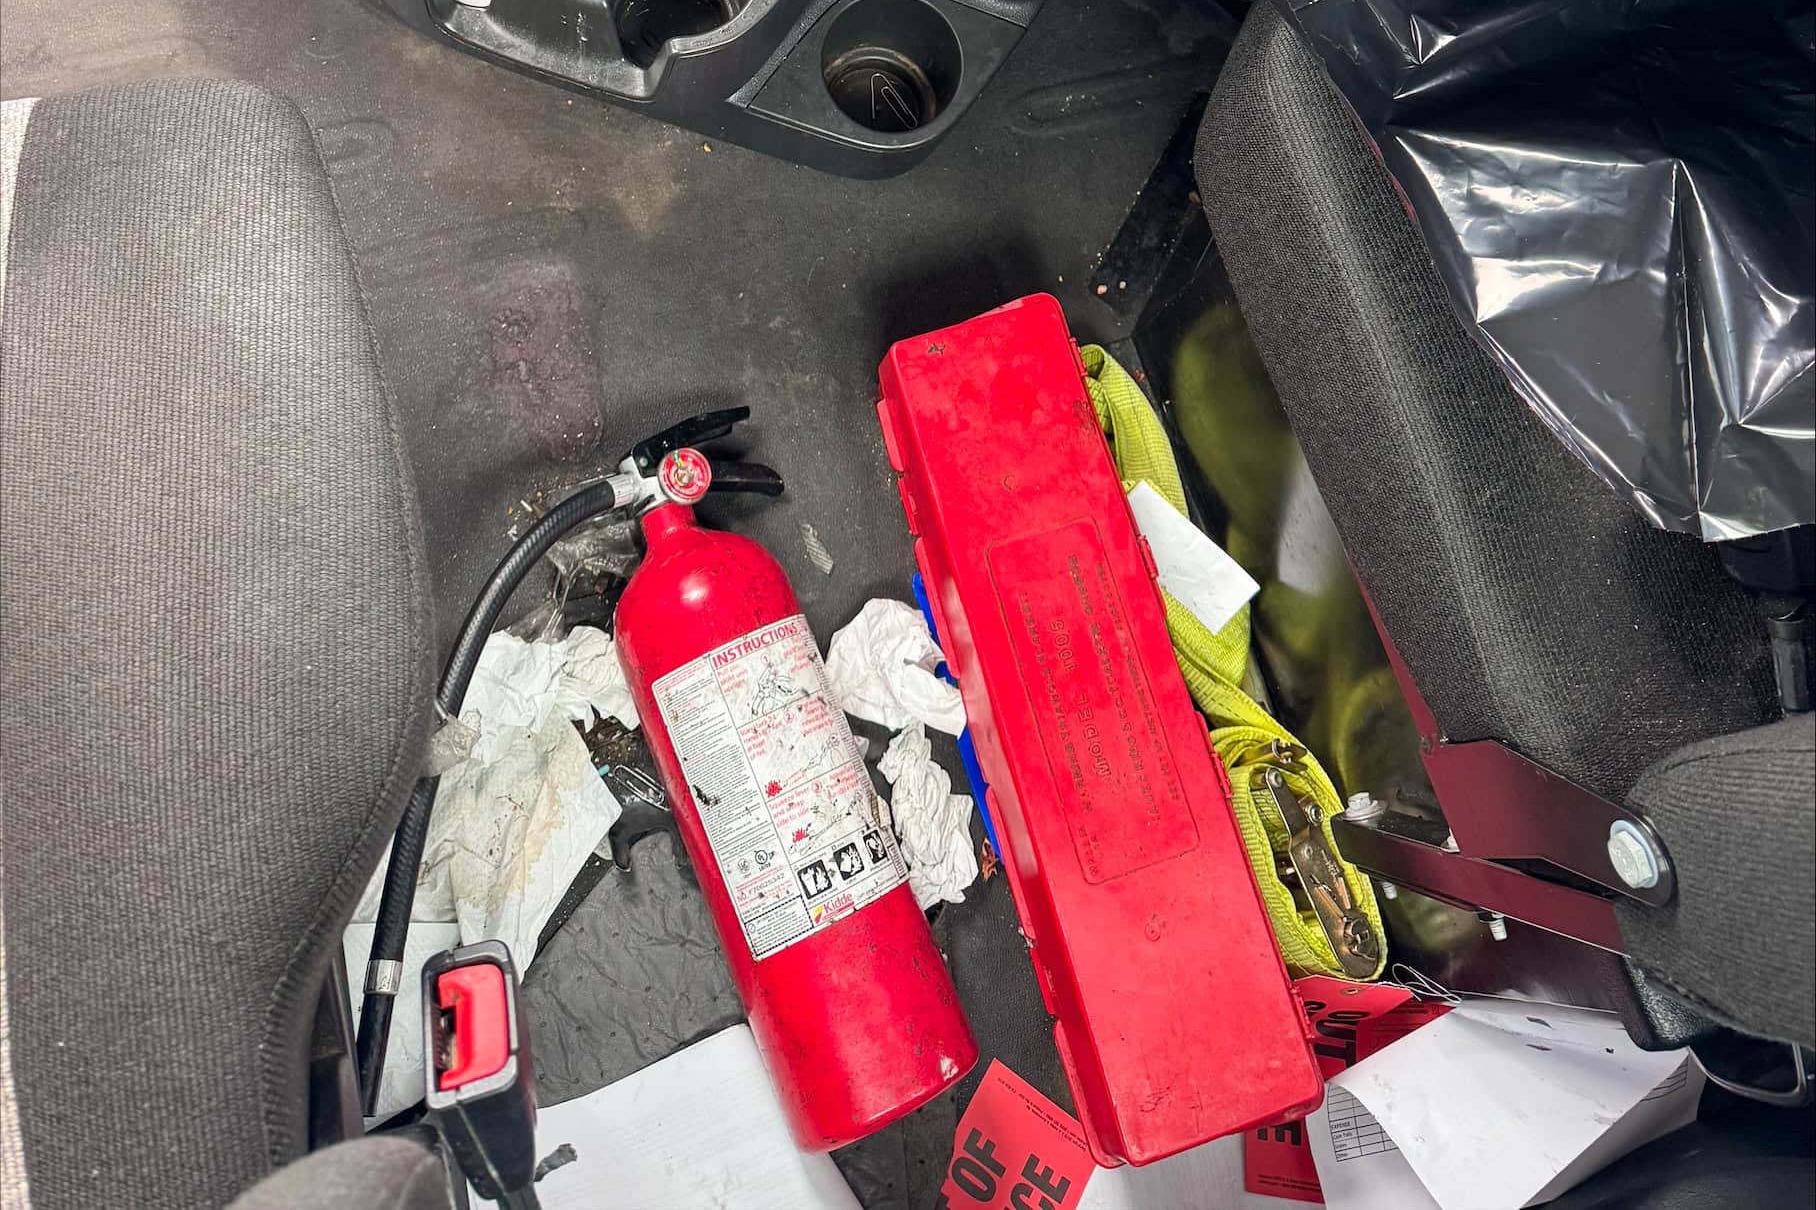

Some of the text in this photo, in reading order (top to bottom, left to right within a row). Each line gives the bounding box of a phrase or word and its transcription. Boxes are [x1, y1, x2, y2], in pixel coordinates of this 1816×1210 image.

[711, 622, 798, 669] INSTRUCTIONS
[1046, 615, 1079, 674] 1005
[1070, 690, 1112, 780] MODEL
[823, 892, 853, 914] Kidde
[951, 1127, 1007, 1203] OF
